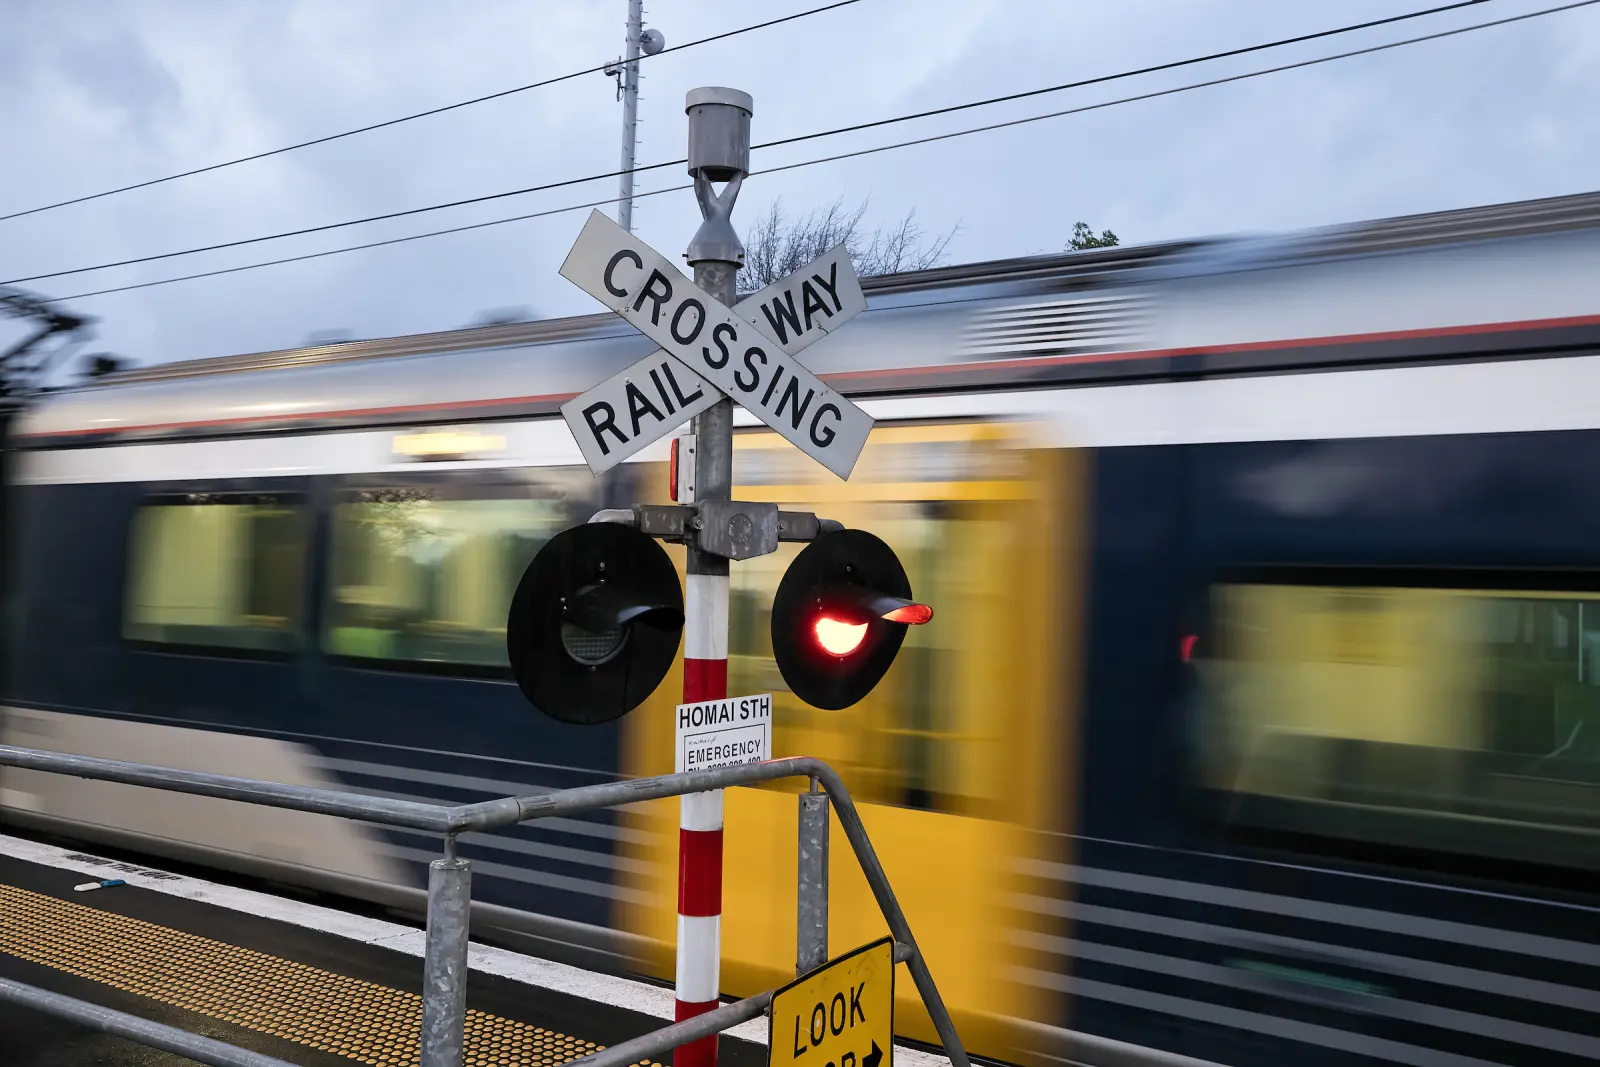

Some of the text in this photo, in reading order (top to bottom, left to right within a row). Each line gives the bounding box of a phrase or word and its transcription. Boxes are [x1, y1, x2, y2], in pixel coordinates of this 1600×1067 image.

[581, 261, 843, 456] RAIL WAY
[603, 249, 842, 448] CROSSING
[679, 697, 769, 729] HOMAI STH
[688, 739, 761, 764] EMERGENCY
[793, 981, 866, 1059] LOOK
